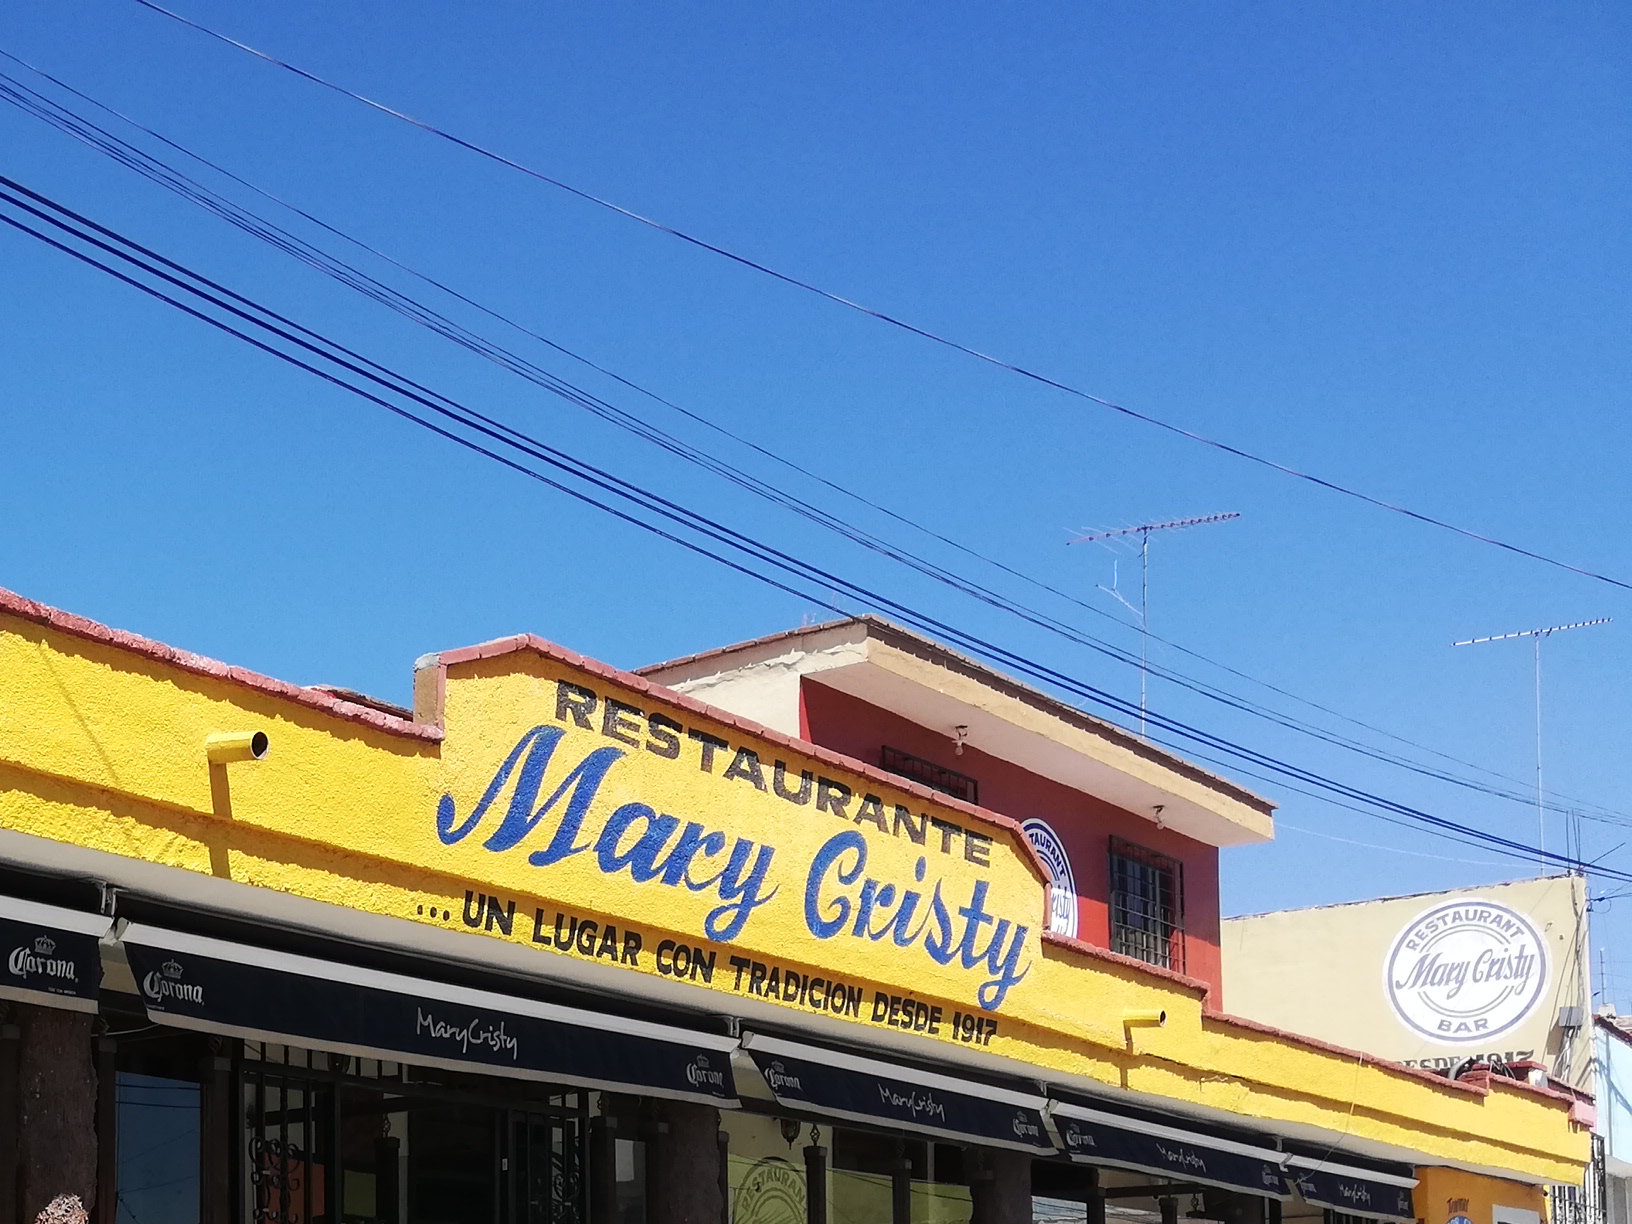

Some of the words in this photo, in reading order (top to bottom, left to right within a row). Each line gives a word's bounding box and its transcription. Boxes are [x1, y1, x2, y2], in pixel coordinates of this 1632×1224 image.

[555, 679, 995, 868] RESTAURANTE
[436, 725, 779, 942] Mary
[805, 830, 1033, 1011] Cristy
[1028, 832, 1066, 877] TAURANT
[1405, 908, 1526, 952] RESTAURANT
[8, 946, 77, 980] Corona
[532, 908, 642, 967] LUGAR
[656, 939, 716, 984] CON
[729, 955, 864, 1018] TRADICION
[871, 993, 943, 1034] DESDE
[952, 1011, 998, 1047] 1917
[1394, 951, 1471, 1001] Mary
[1472, 944, 1536, 996] Cristy
[142, 970, 204, 1003] Corona
[1436, 1018, 1490, 1034] BAR
[741, 1167, 806, 1212] RESTAURAN
